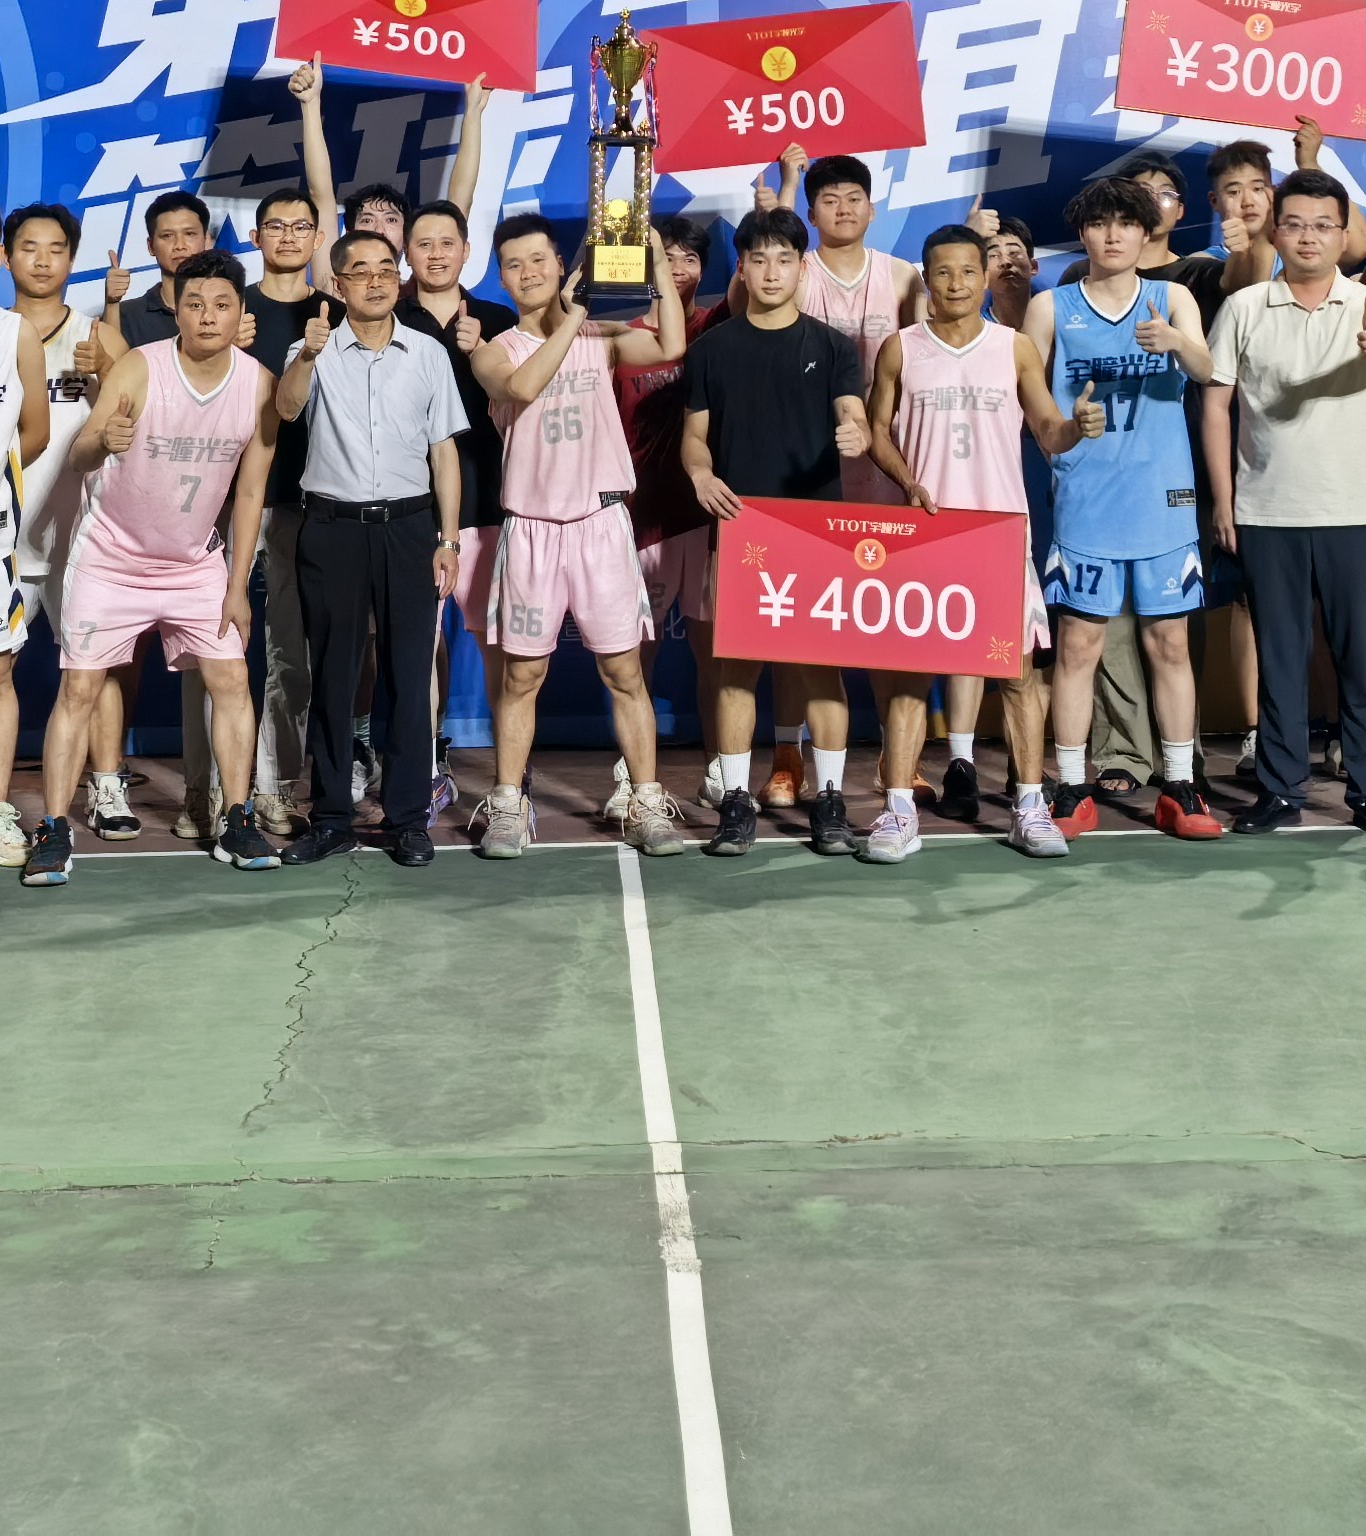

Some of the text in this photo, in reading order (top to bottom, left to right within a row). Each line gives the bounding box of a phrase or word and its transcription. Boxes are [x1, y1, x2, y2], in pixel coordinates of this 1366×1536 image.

[352, 17, 466, 61] ¥500
[1166, 37, 1343, 106] ¥3000
[723, 85, 846, 135] ¥500
[1065, 353, 1165, 384] 宇瞳光学
[912, 385, 1009, 413] 宇瞳光学
[1103, 392, 1139, 432] 17
[542, 405, 583, 445] 66
[952, 423, 971, 460] 3
[143, 434, 244, 463] 宇瞳光学
[180, 475, 202, 513] 7
[1076, 563, 1104, 595] 17
[509, 607, 544, 637] 66
[757, 571, 977, 641] ¥4000
[78, 621, 97, 650] 7
